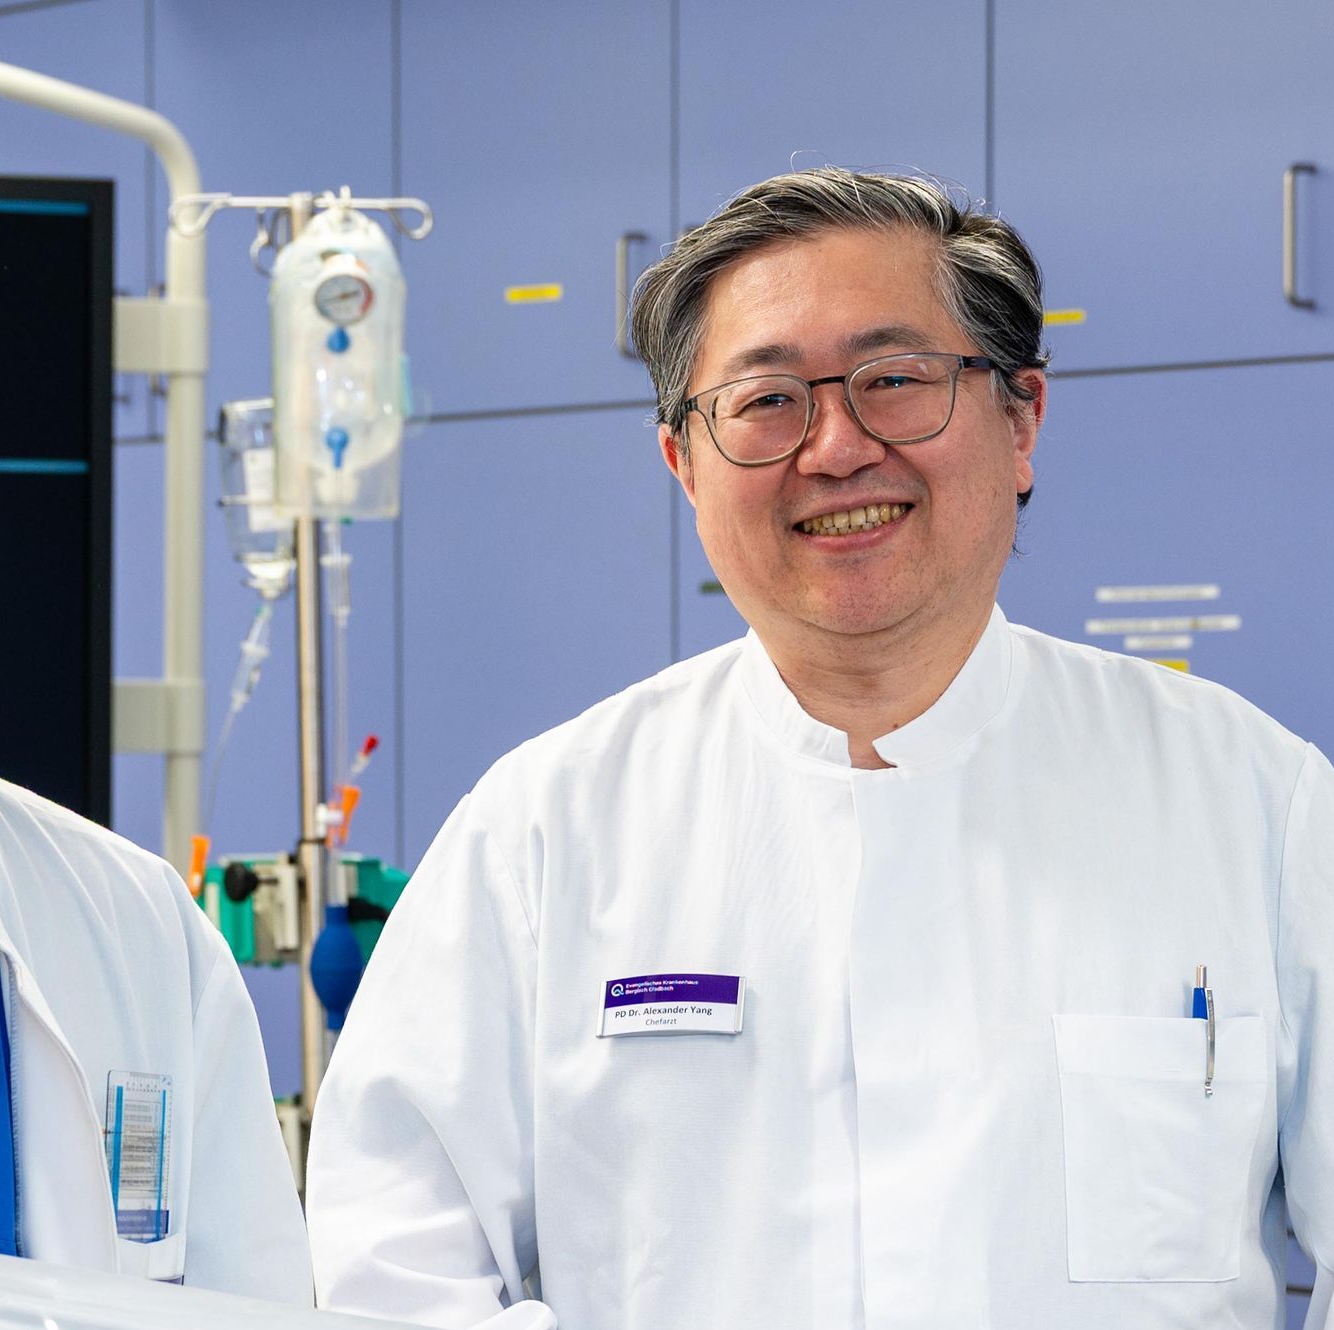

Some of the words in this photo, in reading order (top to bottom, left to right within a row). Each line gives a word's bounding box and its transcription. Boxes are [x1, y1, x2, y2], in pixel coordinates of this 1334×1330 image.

[615, 1010, 627, 1018] PD
[628, 1009, 641, 1017] Dr.
[643, 1006, 688, 1016] Alexander
[690, 1006, 713, 1016] Yang
[645, 1018, 677, 1026] Chefarzt
